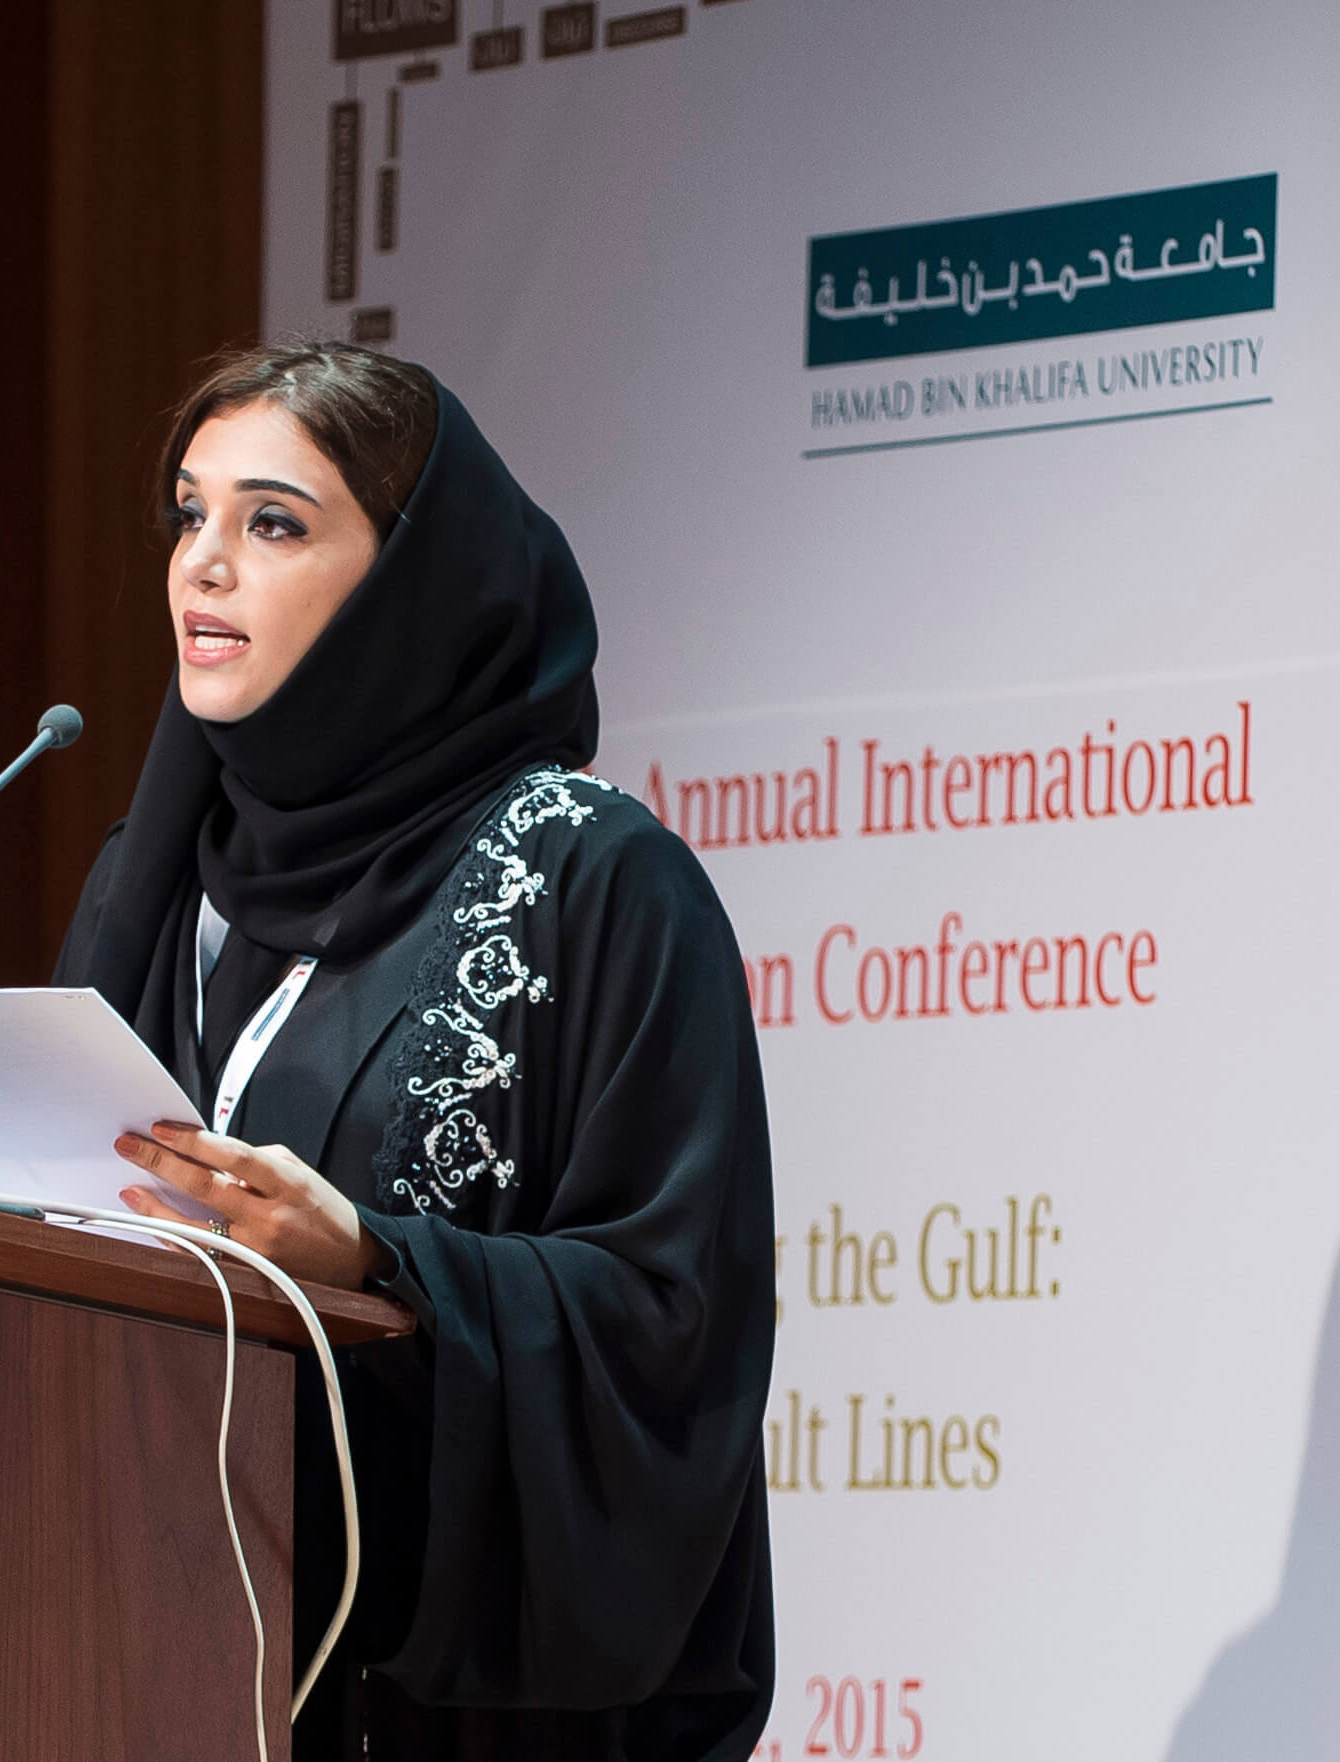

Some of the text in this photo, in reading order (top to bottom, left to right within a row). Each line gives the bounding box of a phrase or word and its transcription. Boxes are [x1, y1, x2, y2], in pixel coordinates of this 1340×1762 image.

[1114, 218, 1267, 280] جامعة
[811, 337, 1265, 429] HAMAD BIN KHALIFA UNIVERSITY
[641, 700, 1254, 851] Annual International
[813, 911, 1159, 1027] Conference
[806, 1203, 899, 1308] the
[918, 1193, 1062, 1307] Gulf:
[766, 1390, 1002, 1493] ult Lines
[803, 1674, 926, 1761] 2015
